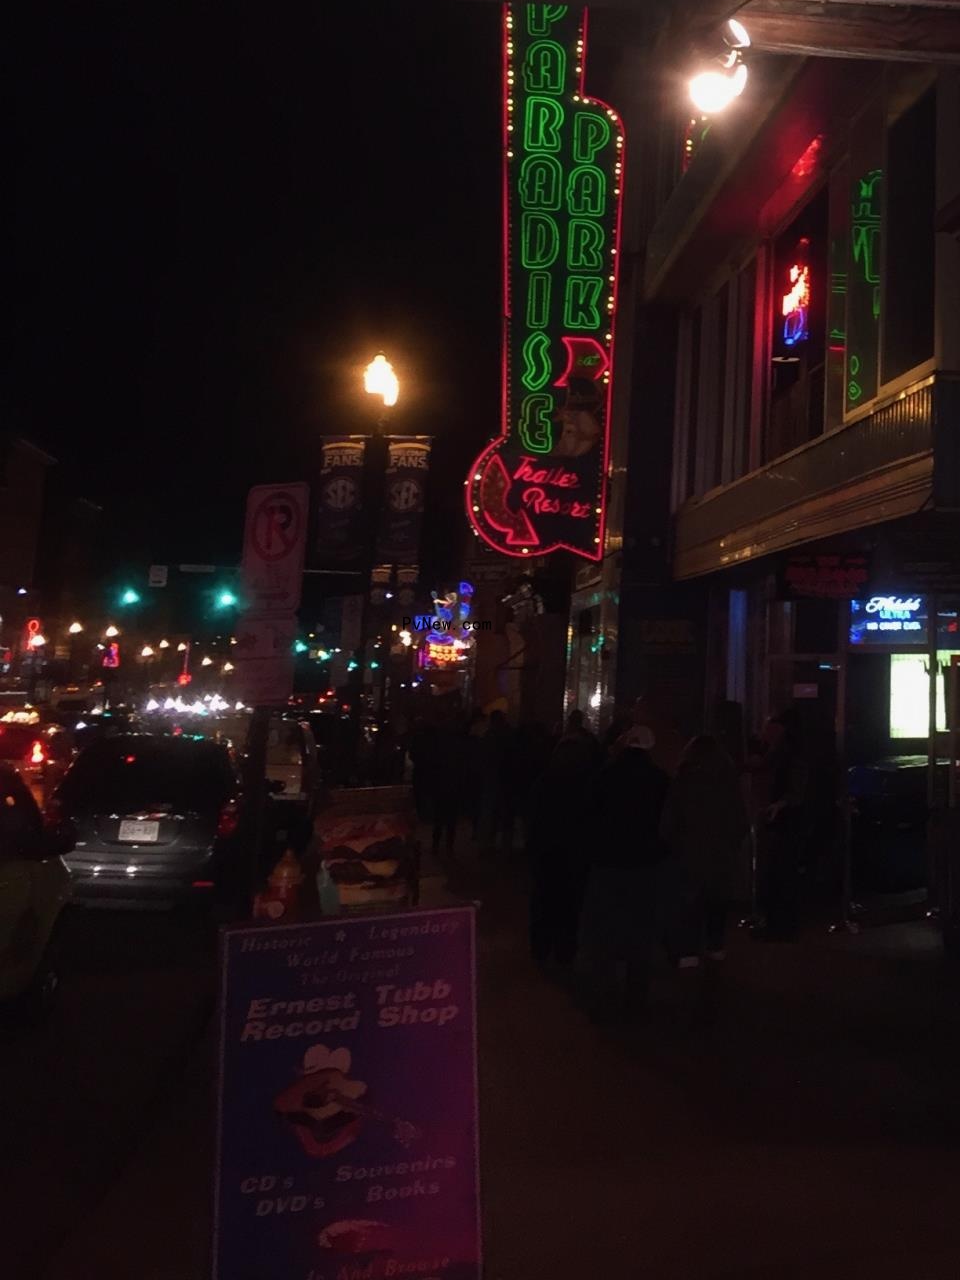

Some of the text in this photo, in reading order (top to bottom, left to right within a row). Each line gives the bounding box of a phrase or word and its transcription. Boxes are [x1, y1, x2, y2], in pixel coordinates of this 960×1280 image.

[518, 3, 568, 454] PARADISE
[563, 111, 610, 330] PARK
[522, 487, 592, 518] Resort
[368, 920, 461, 940] Legendary
[350, 945, 415, 963] Famous
[247, 978, 452, 1020] Ernest Tubb
[240, 1004, 459, 1042] Record Shop
[335, 1155, 457, 1183] Souvenirs
[240, 1175, 296, 1194] CD's
[365, 1180, 441, 1203] Books
[255, 1194, 326, 1217] DVD's
